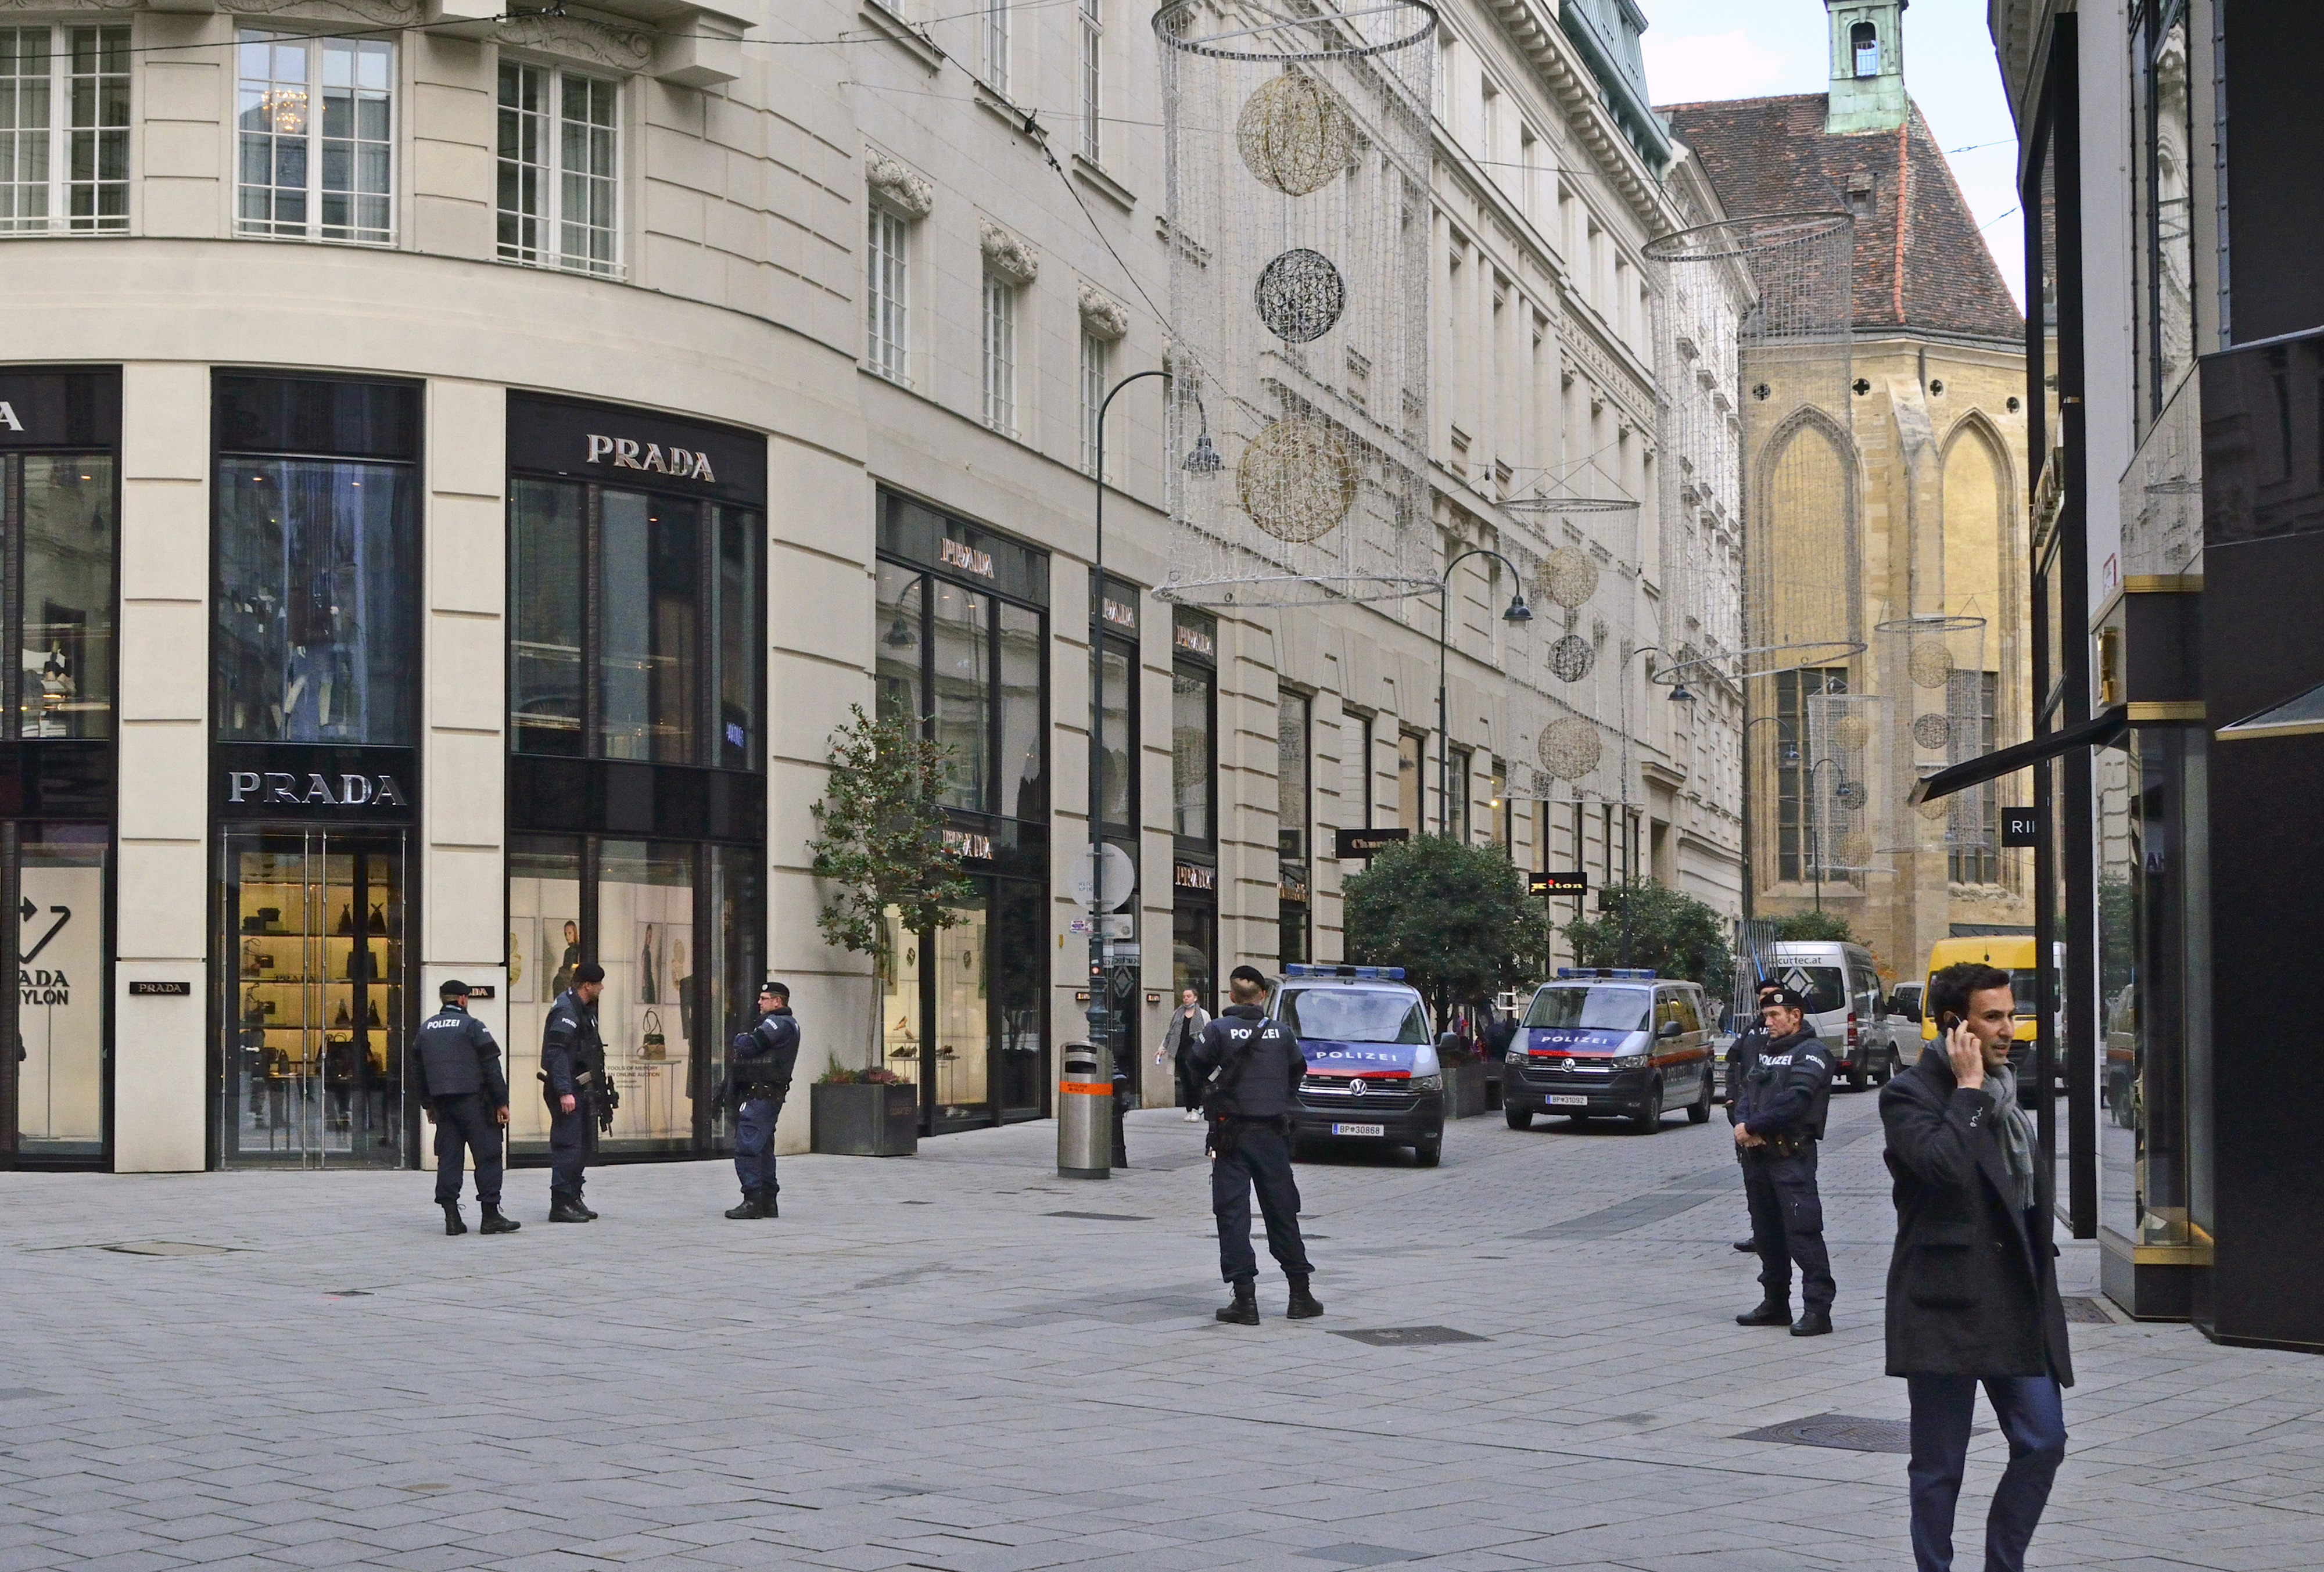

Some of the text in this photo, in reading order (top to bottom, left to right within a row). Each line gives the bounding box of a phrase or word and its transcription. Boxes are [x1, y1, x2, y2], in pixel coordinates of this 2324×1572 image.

[586, 433, 716, 483] PRADA
[940, 537, 995, 580] PRADA
[1092, 594, 1135, 629] RADA
[1175, 625, 1213, 656] PRADA
[228, 771, 407, 806] PRADA
[2011, 820, 2035, 834] RI
[1175, 866, 1213, 890] PRADA
[1530, 879, 1583, 892] Kiton
[138, 984, 182, 993] PRADA
[19, 989, 69, 1006] YLON
[426, 1018, 460, 1030] POLIZEI
[1230, 1028, 1280, 1039] POZEI
[1541, 1036, 1608, 1045] POLIZEI
[1316, 1051, 1397, 1061] POLIZEI
[1758, 1053, 1793, 1065] POLIZEI
